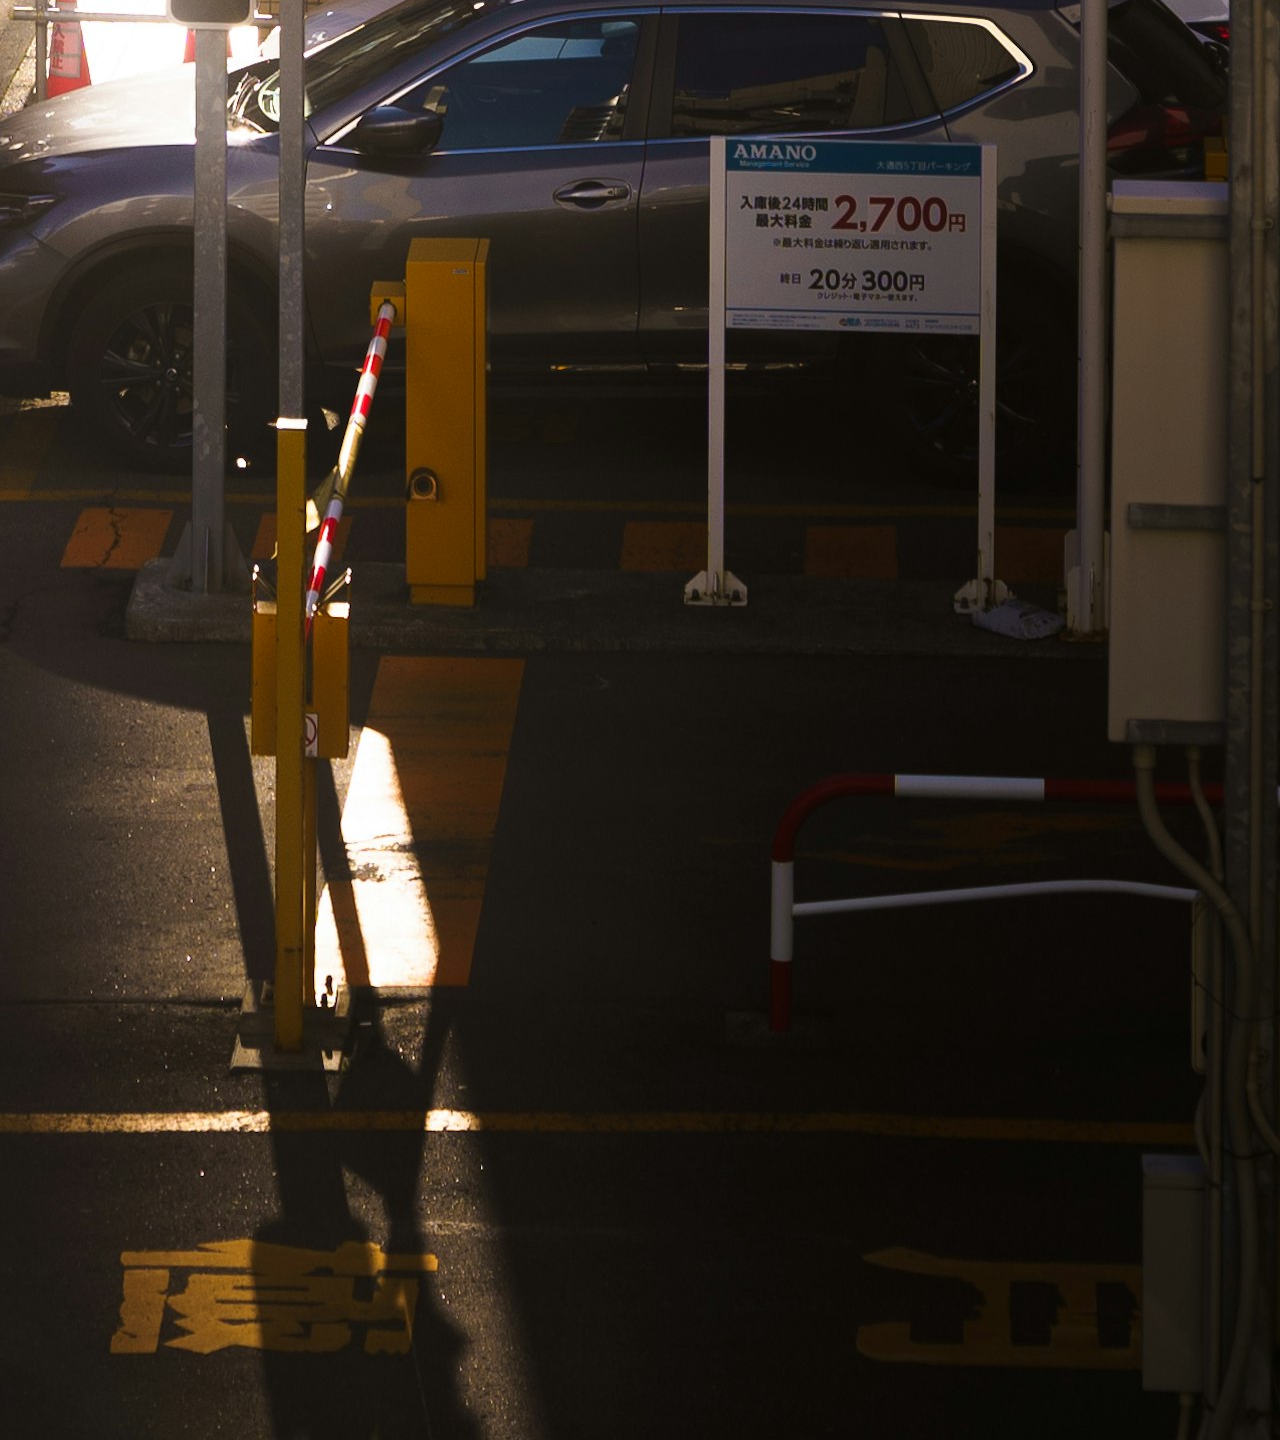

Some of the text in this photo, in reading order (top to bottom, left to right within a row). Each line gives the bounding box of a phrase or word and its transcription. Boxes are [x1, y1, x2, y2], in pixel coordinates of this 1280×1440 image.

[51, 22, 65, 70] 入禁止
[733, 143, 817, 161] AMANO
[740, 195, 829, 211] 入庫後24時間
[831, 194, 966, 233] 2,700円
[755, 213, 813, 229] 最大料金
[780, 268, 926, 292] 終日 20分 300円
